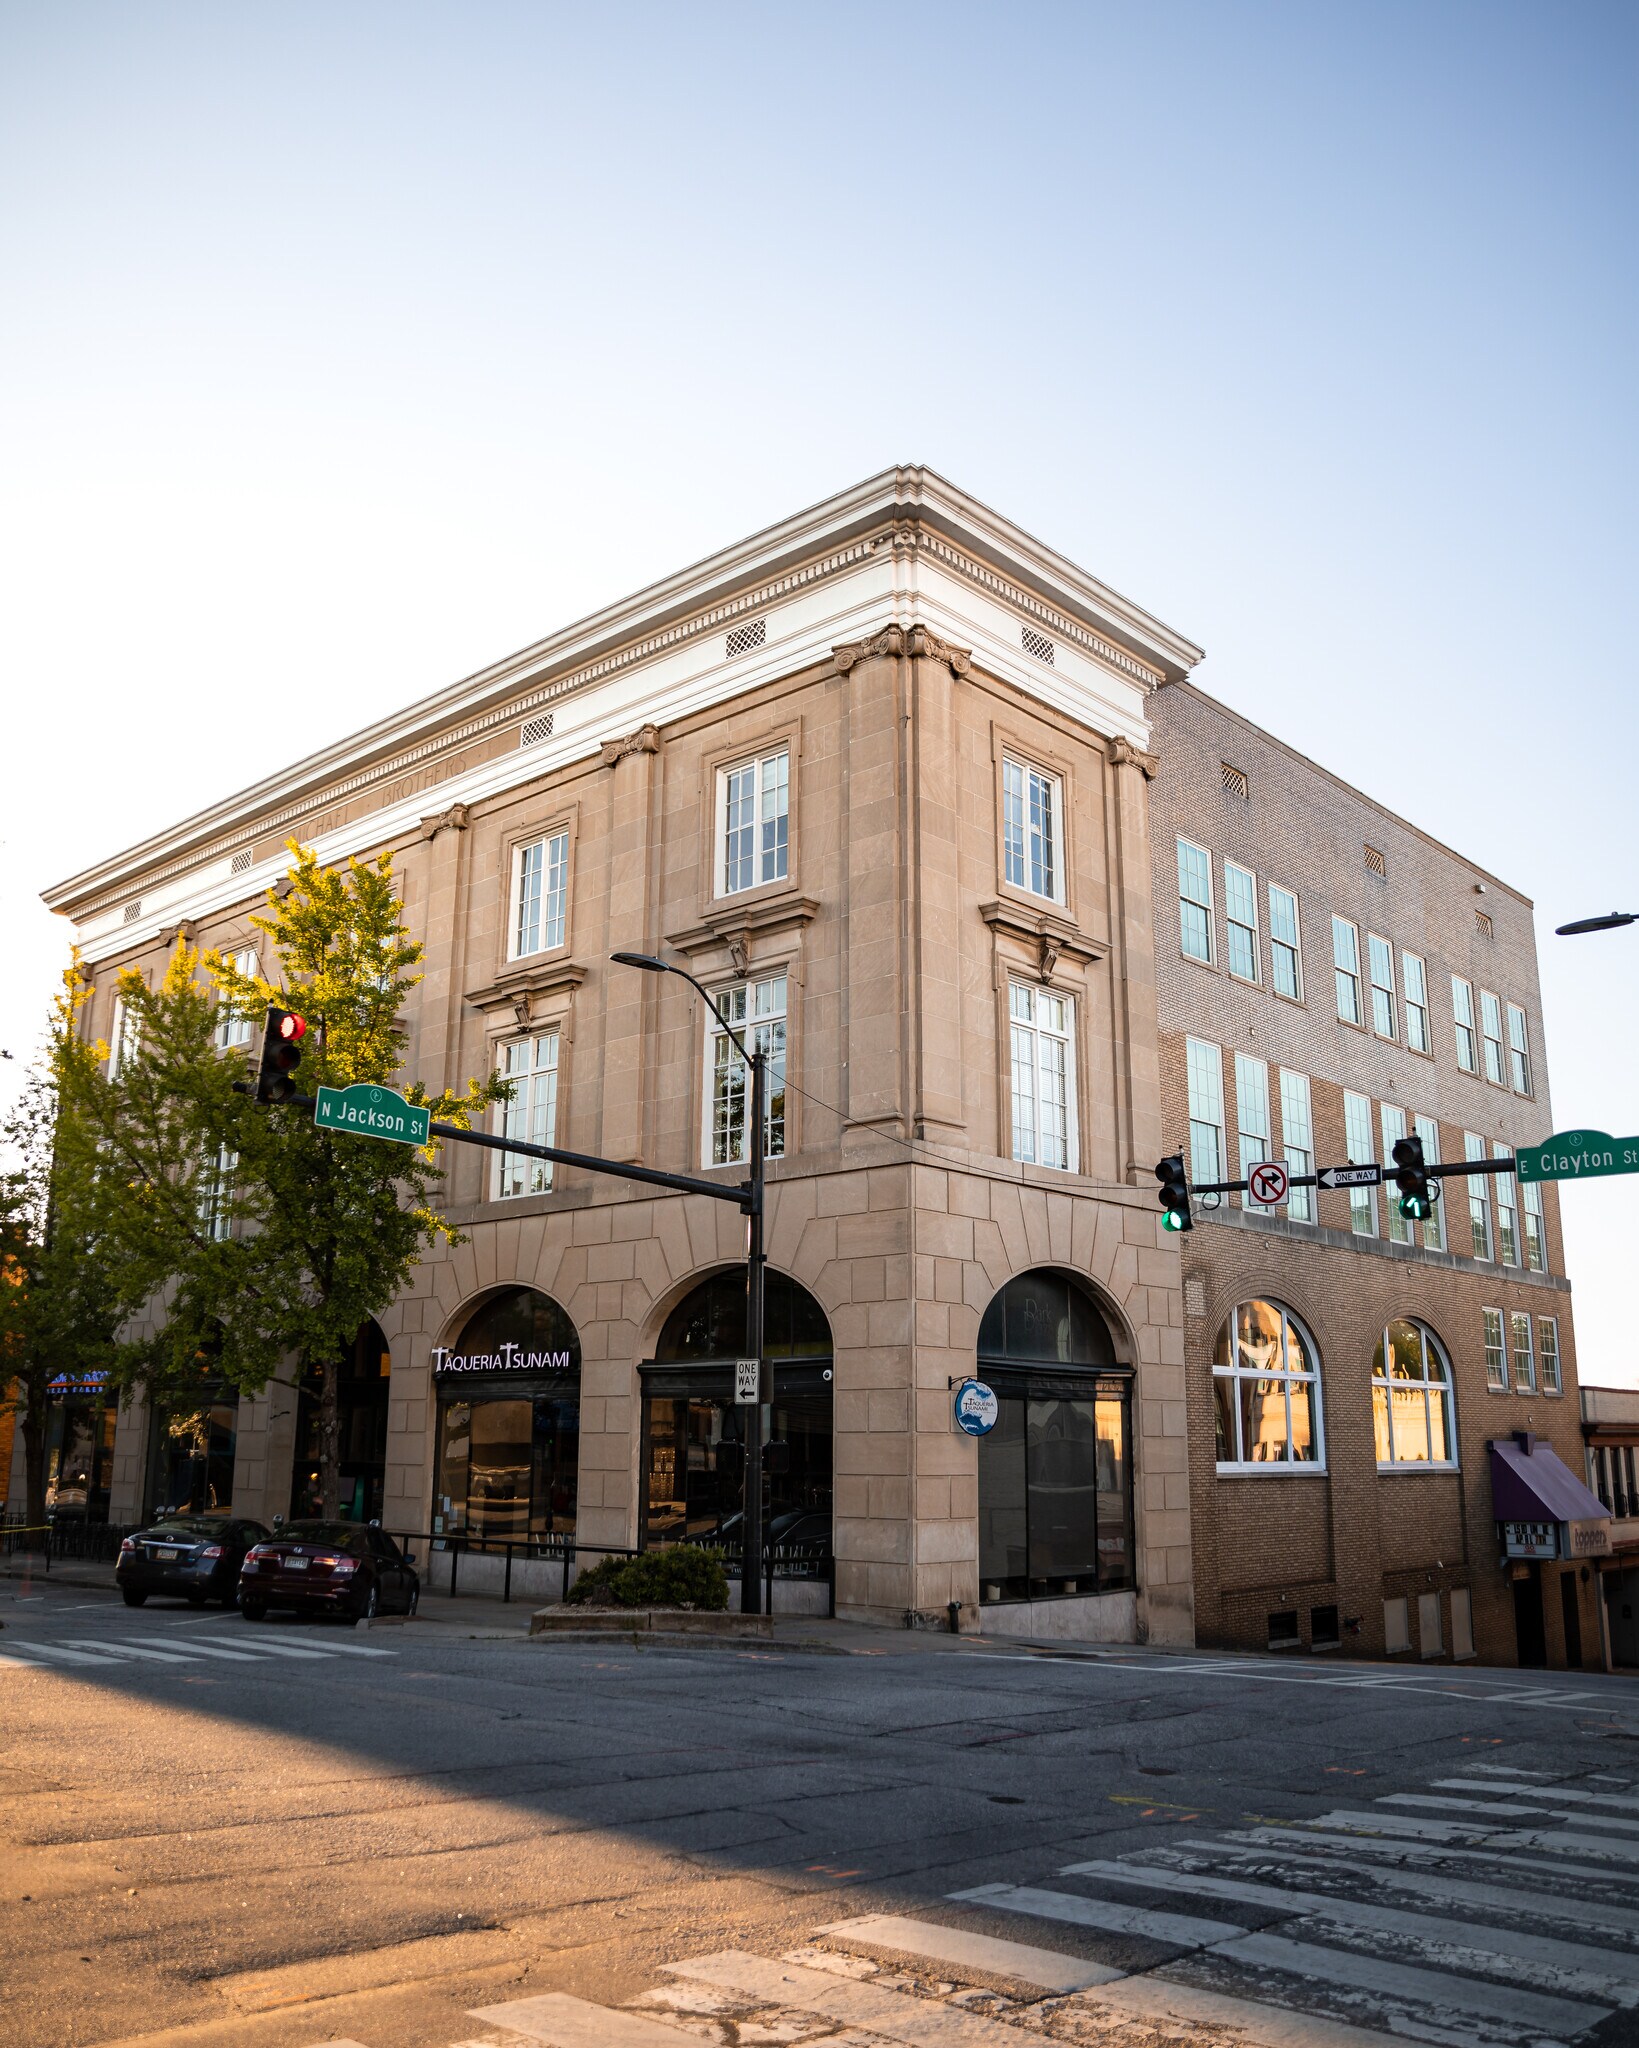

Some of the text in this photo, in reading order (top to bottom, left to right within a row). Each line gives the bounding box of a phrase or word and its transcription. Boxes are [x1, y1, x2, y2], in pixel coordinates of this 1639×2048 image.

[322, 1102, 424, 1135] N Jackson St
[1520, 1149, 1638, 1174] E Clayton St
[1335, 1170, 1375, 1182] ONE WAY
[431, 1342, 570, 1372] TAQUERIA TSUNAMI
[738, 1363, 757, 1374] ONE
[738, 1375, 757, 1386] WAY
[963, 1402, 989, 1411] TSUNAMI
[967, 1397, 995, 1407] TAQUERIA
